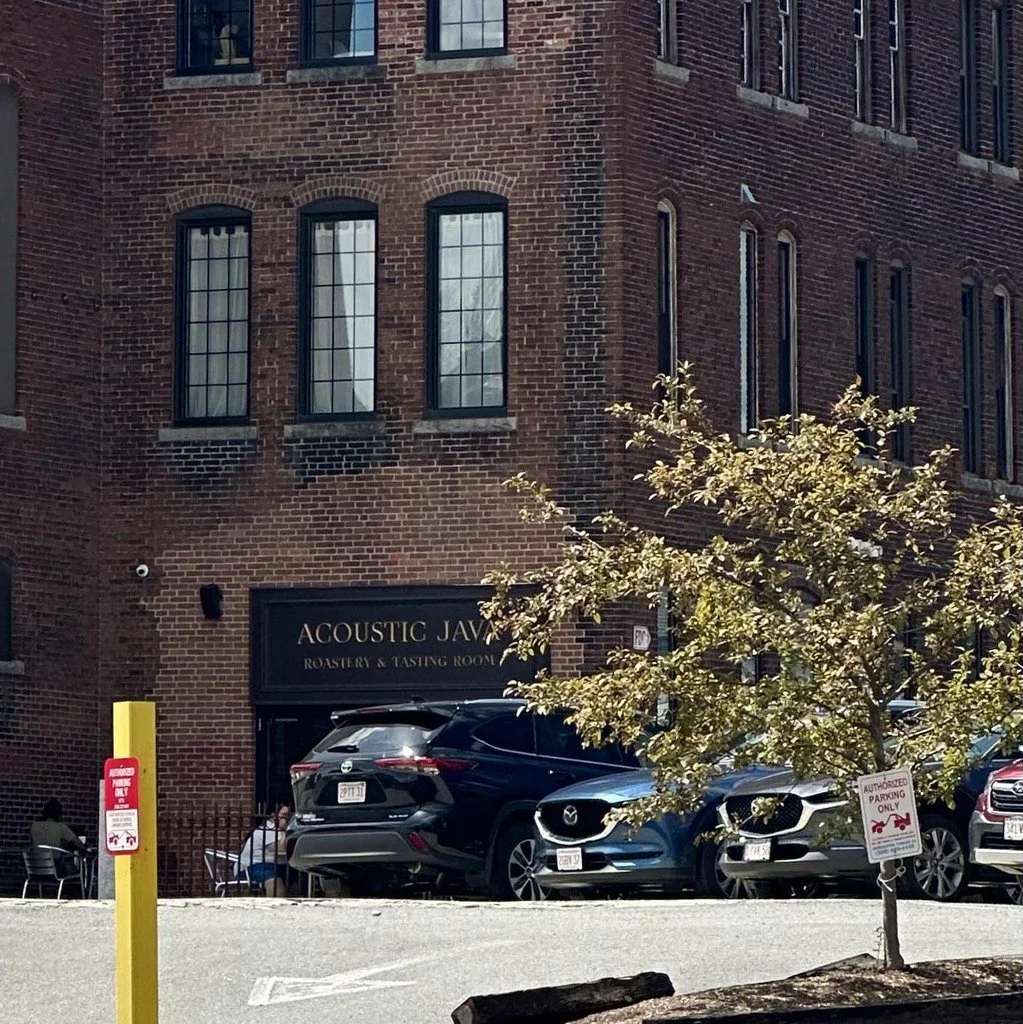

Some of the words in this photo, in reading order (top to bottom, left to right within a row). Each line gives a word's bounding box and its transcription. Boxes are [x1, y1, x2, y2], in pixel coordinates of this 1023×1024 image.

[297, 620, 427, 645] ACOUSTIC
[436, 619, 501, 642] JAVA
[304, 656, 373, 670] ROASTERY
[377, 656, 387, 668] &
[391, 655, 448, 669] TASTING
[453, 654, 496, 668] ROOM
[863, 777, 908, 794] AUTHORIZED
[868, 789, 906, 804] PARKING
[877, 801, 900, 814] ONLY
